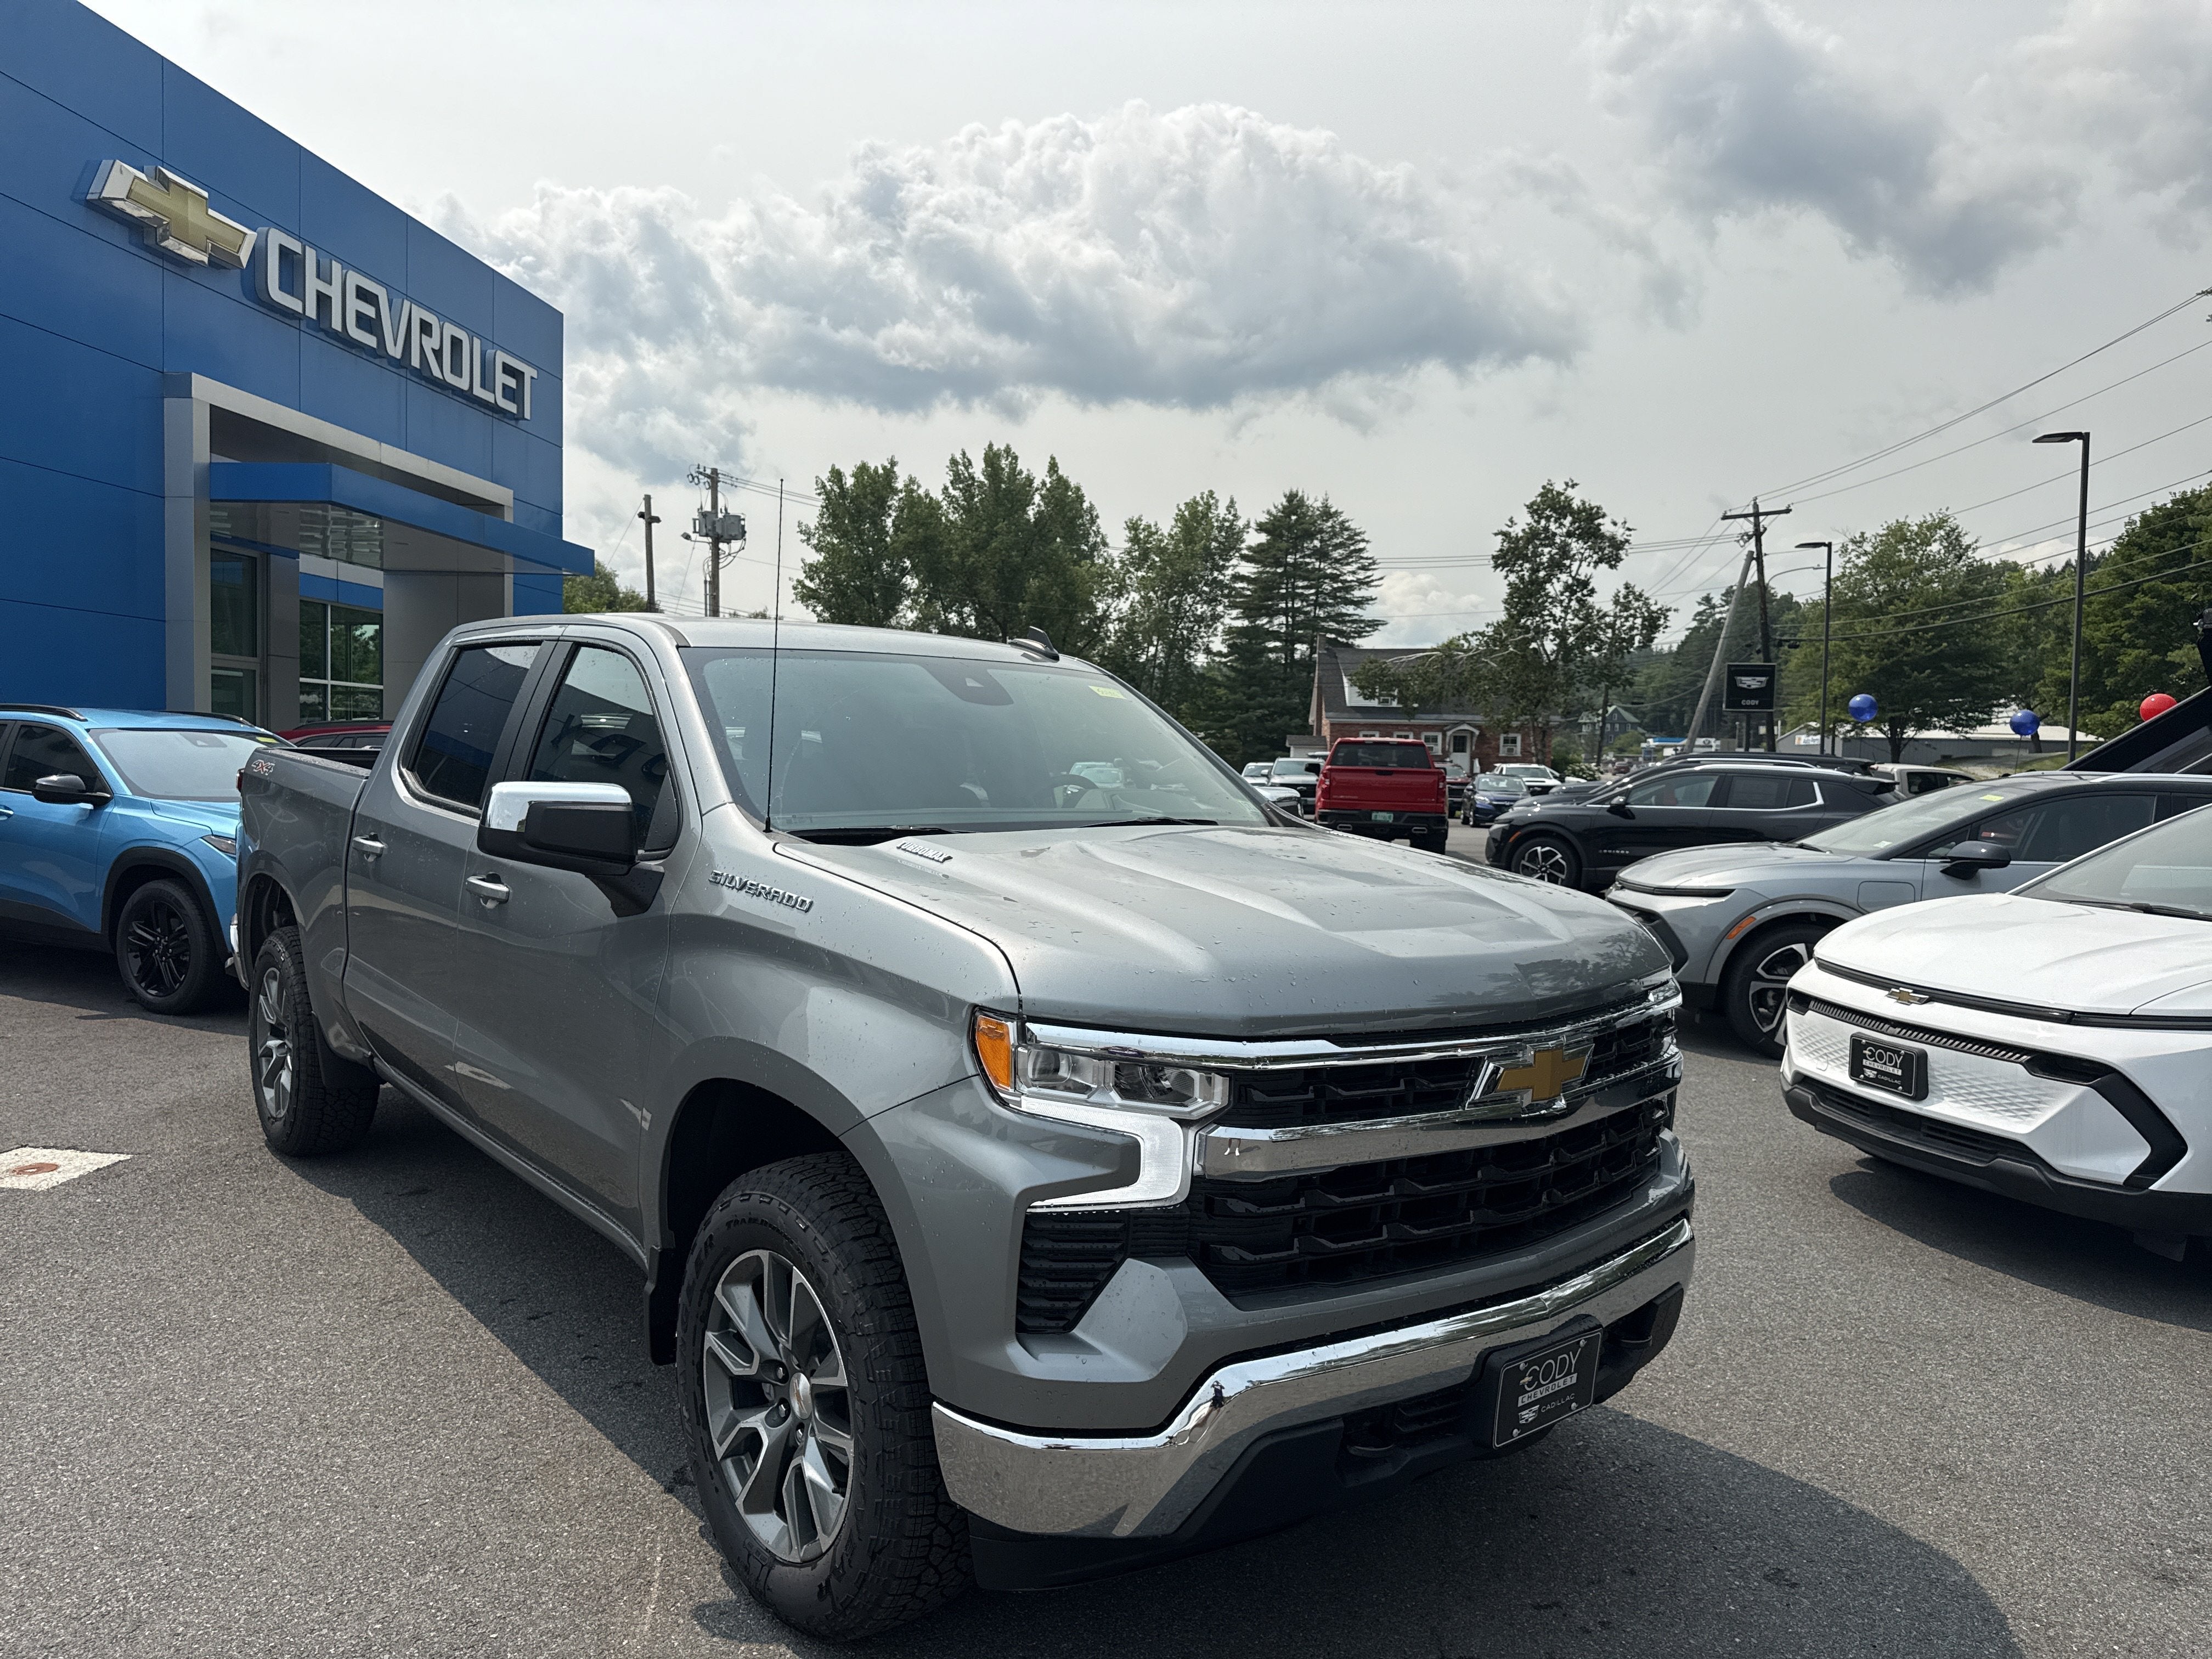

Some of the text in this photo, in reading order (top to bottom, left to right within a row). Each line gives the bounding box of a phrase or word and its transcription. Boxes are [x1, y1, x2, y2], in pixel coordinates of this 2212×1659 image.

[259, 227, 538, 420] CHEVROLET
[896, 840, 951, 864] TURBOMAX
[708, 870, 814, 913] SILVERADO
[1864, 1060, 1901, 1074] CHEVROLET
[1865, 1046, 1903, 1069] CODY
[1877, 1074, 1901, 1085] CADILLAC
[1523, 1347, 1582, 1391] CODY
[1520, 1375, 1576, 1403] CHEVROLET
[1541, 1393, 1576, 1413] CADILLAC
